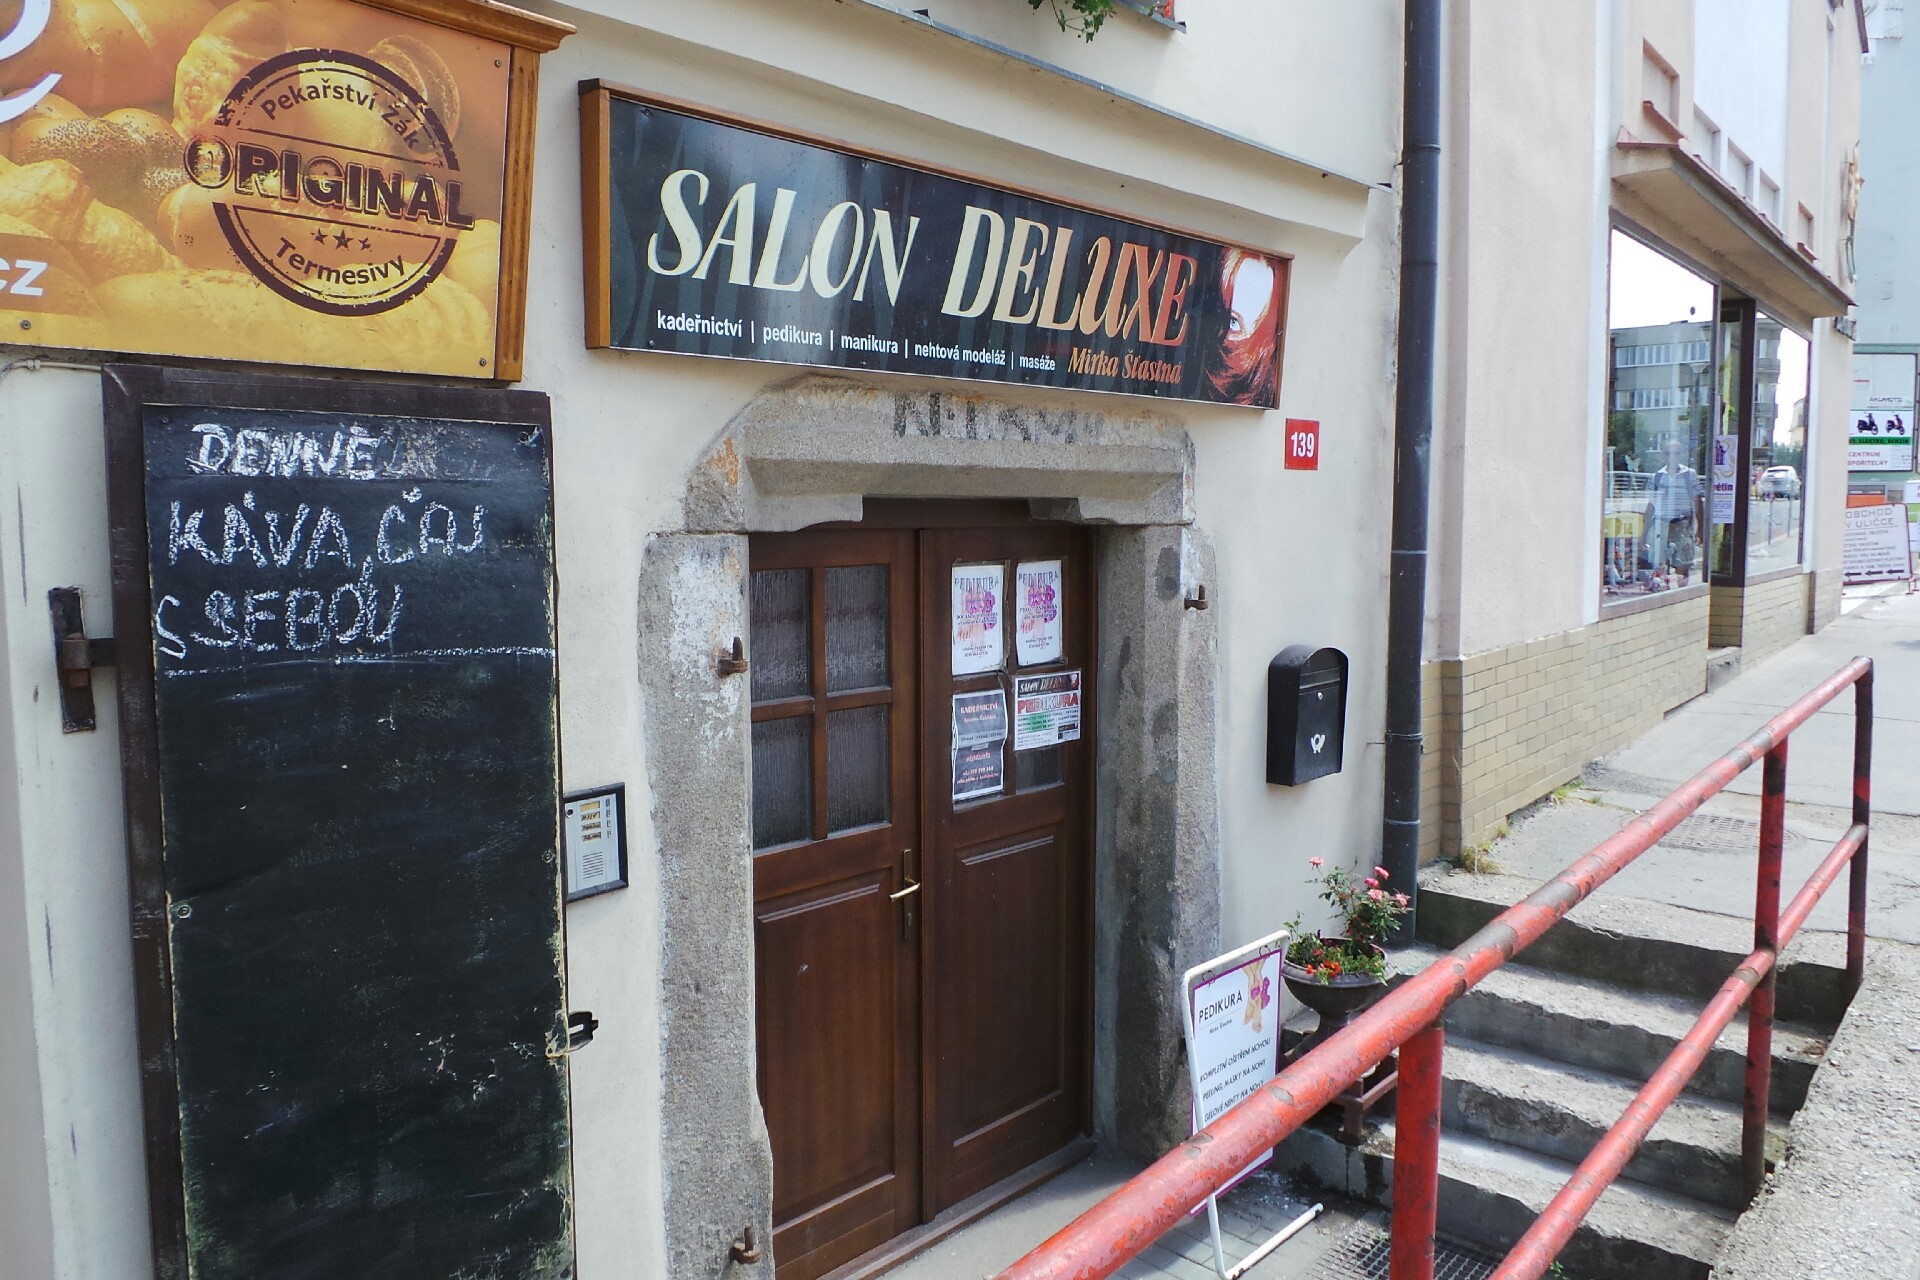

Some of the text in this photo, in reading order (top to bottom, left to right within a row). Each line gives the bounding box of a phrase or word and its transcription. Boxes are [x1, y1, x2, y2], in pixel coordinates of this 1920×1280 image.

[260, 78, 377, 121] Pekařství
[184, 134, 475, 231] ORIGINAL
[273, 236, 404, 286] Termesivy
[647, 169, 1198, 347] SALON DELUXE
[657, 309, 1056, 371] kadeřnictví pedikura manikura nehtová modeláž masáže
[1067, 346, 1183, 385] Mirka Šťastná
[1291, 431, 1315, 458] 139
[377, 487, 488, 565] ČAJ
[954, 576, 999, 594] PEDIKURA
[1019, 571, 1058, 590] PEDIKURA
[155, 594, 188, 660] S
[1018, 692, 1078, 715] PEDIKURA
[1199, 990, 1242, 1024] PEDIKURA
